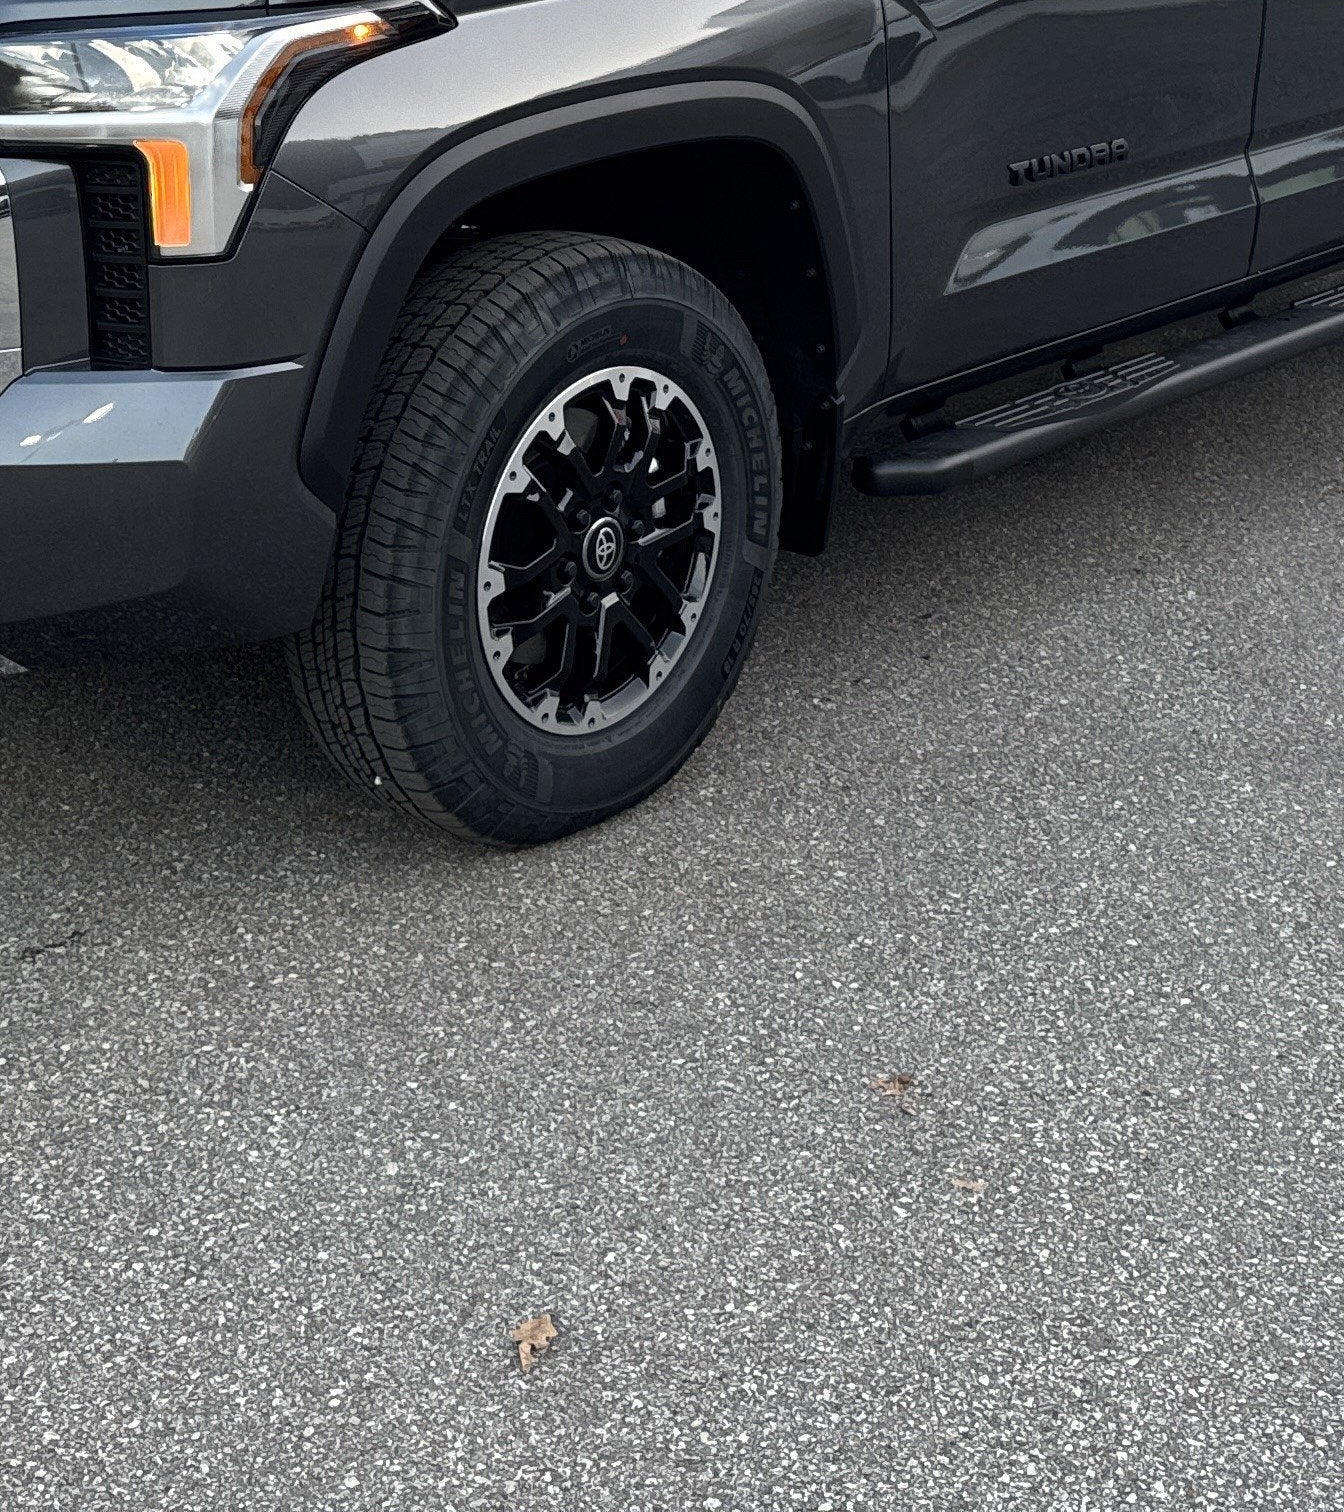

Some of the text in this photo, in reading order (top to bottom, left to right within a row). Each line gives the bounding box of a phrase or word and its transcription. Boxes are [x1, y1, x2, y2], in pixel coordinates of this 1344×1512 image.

[1007, 138, 1130, 186] TUNDRA
[723, 367, 768, 535] MICHELIN
[448, 570, 504, 756] MICHELIN
